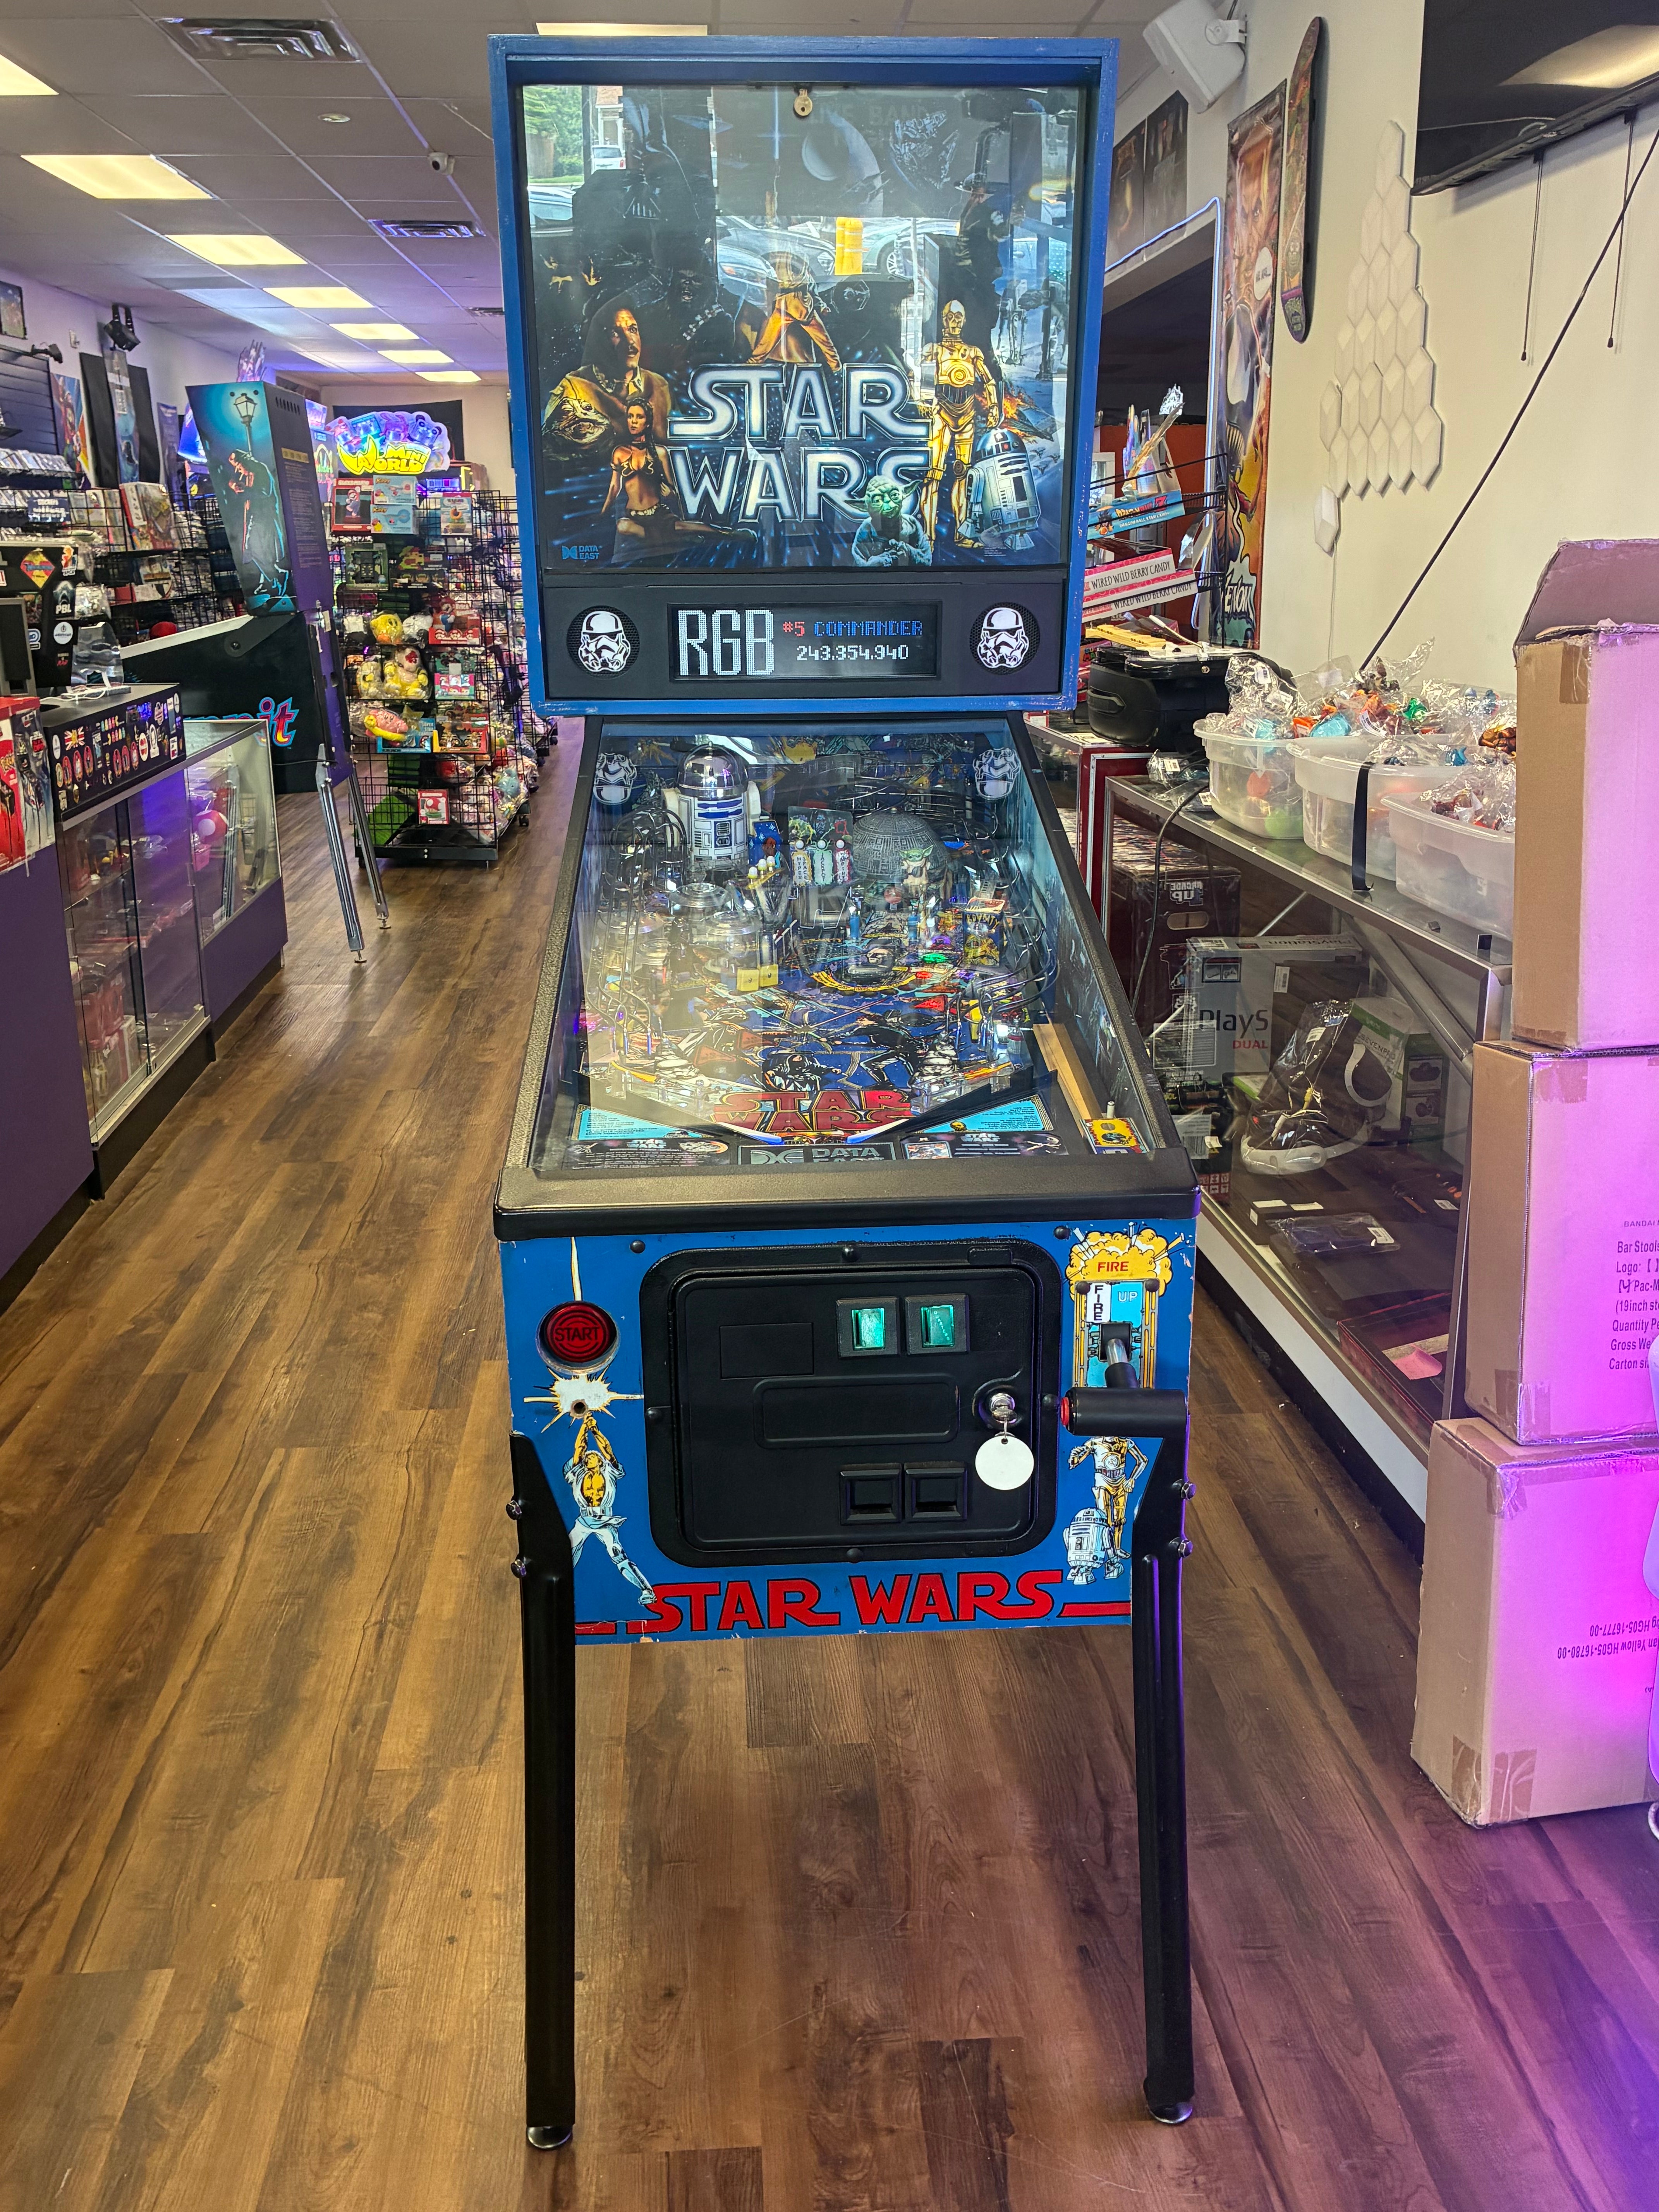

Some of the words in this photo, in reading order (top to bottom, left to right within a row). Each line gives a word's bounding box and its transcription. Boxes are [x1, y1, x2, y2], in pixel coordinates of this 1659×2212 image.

[667, 363, 929, 441] STAR
[338, 435, 424, 474] WORLD
[385, 444, 427, 464] MINI
[668, 446, 929, 523] WARS
[1091, 576, 1112, 589] WIRED
[1113, 572, 1130, 584] WILD
[1130, 567, 1149, 580] BERRY
[1150, 561, 1170, 574] CANDY
[1114, 598, 1134, 610] WIRED
[1135, 594, 1152, 604] WILD
[1152, 588, 1171, 599] BERRY
[1171, 582, 1192, 594] CANDY
[56, 604, 72, 614] PBL
[783, 621, 805, 637] #5
[814, 620, 922, 637] COMMANDER
[678, 610, 774, 676] RGB
[967, 914, 1000, 930] BOUNTY
[1233, 1040, 1268, 1049] DUAL
[714, 1091, 911, 1113] STAR
[711, 1110, 918, 1132] WARS
[812, 1147, 880, 1158] DATA
[1618, 1241, 1633, 1253] Bar
[1097, 1261, 1129, 1272] FIRE
[1616, 1261, 1641, 1276] Logo:
[1094, 1285, 1104, 1321] FIRE
[1118, 1291, 1138, 1302] UP
[555, 1326, 600, 1341] START
[1613, 1319, 1649, 1333] Quantity
[1611, 1339, 1636, 1351] Gross
[1609, 1358, 1637, 1370] Carton
[627, 1579, 840, 1633] STAR
[849, 1570, 1063, 1625] WARS
[1557, 1642, 1619, 1659] HG05-16780-00
[1620, 1639, 1646, 1653] Yellow
